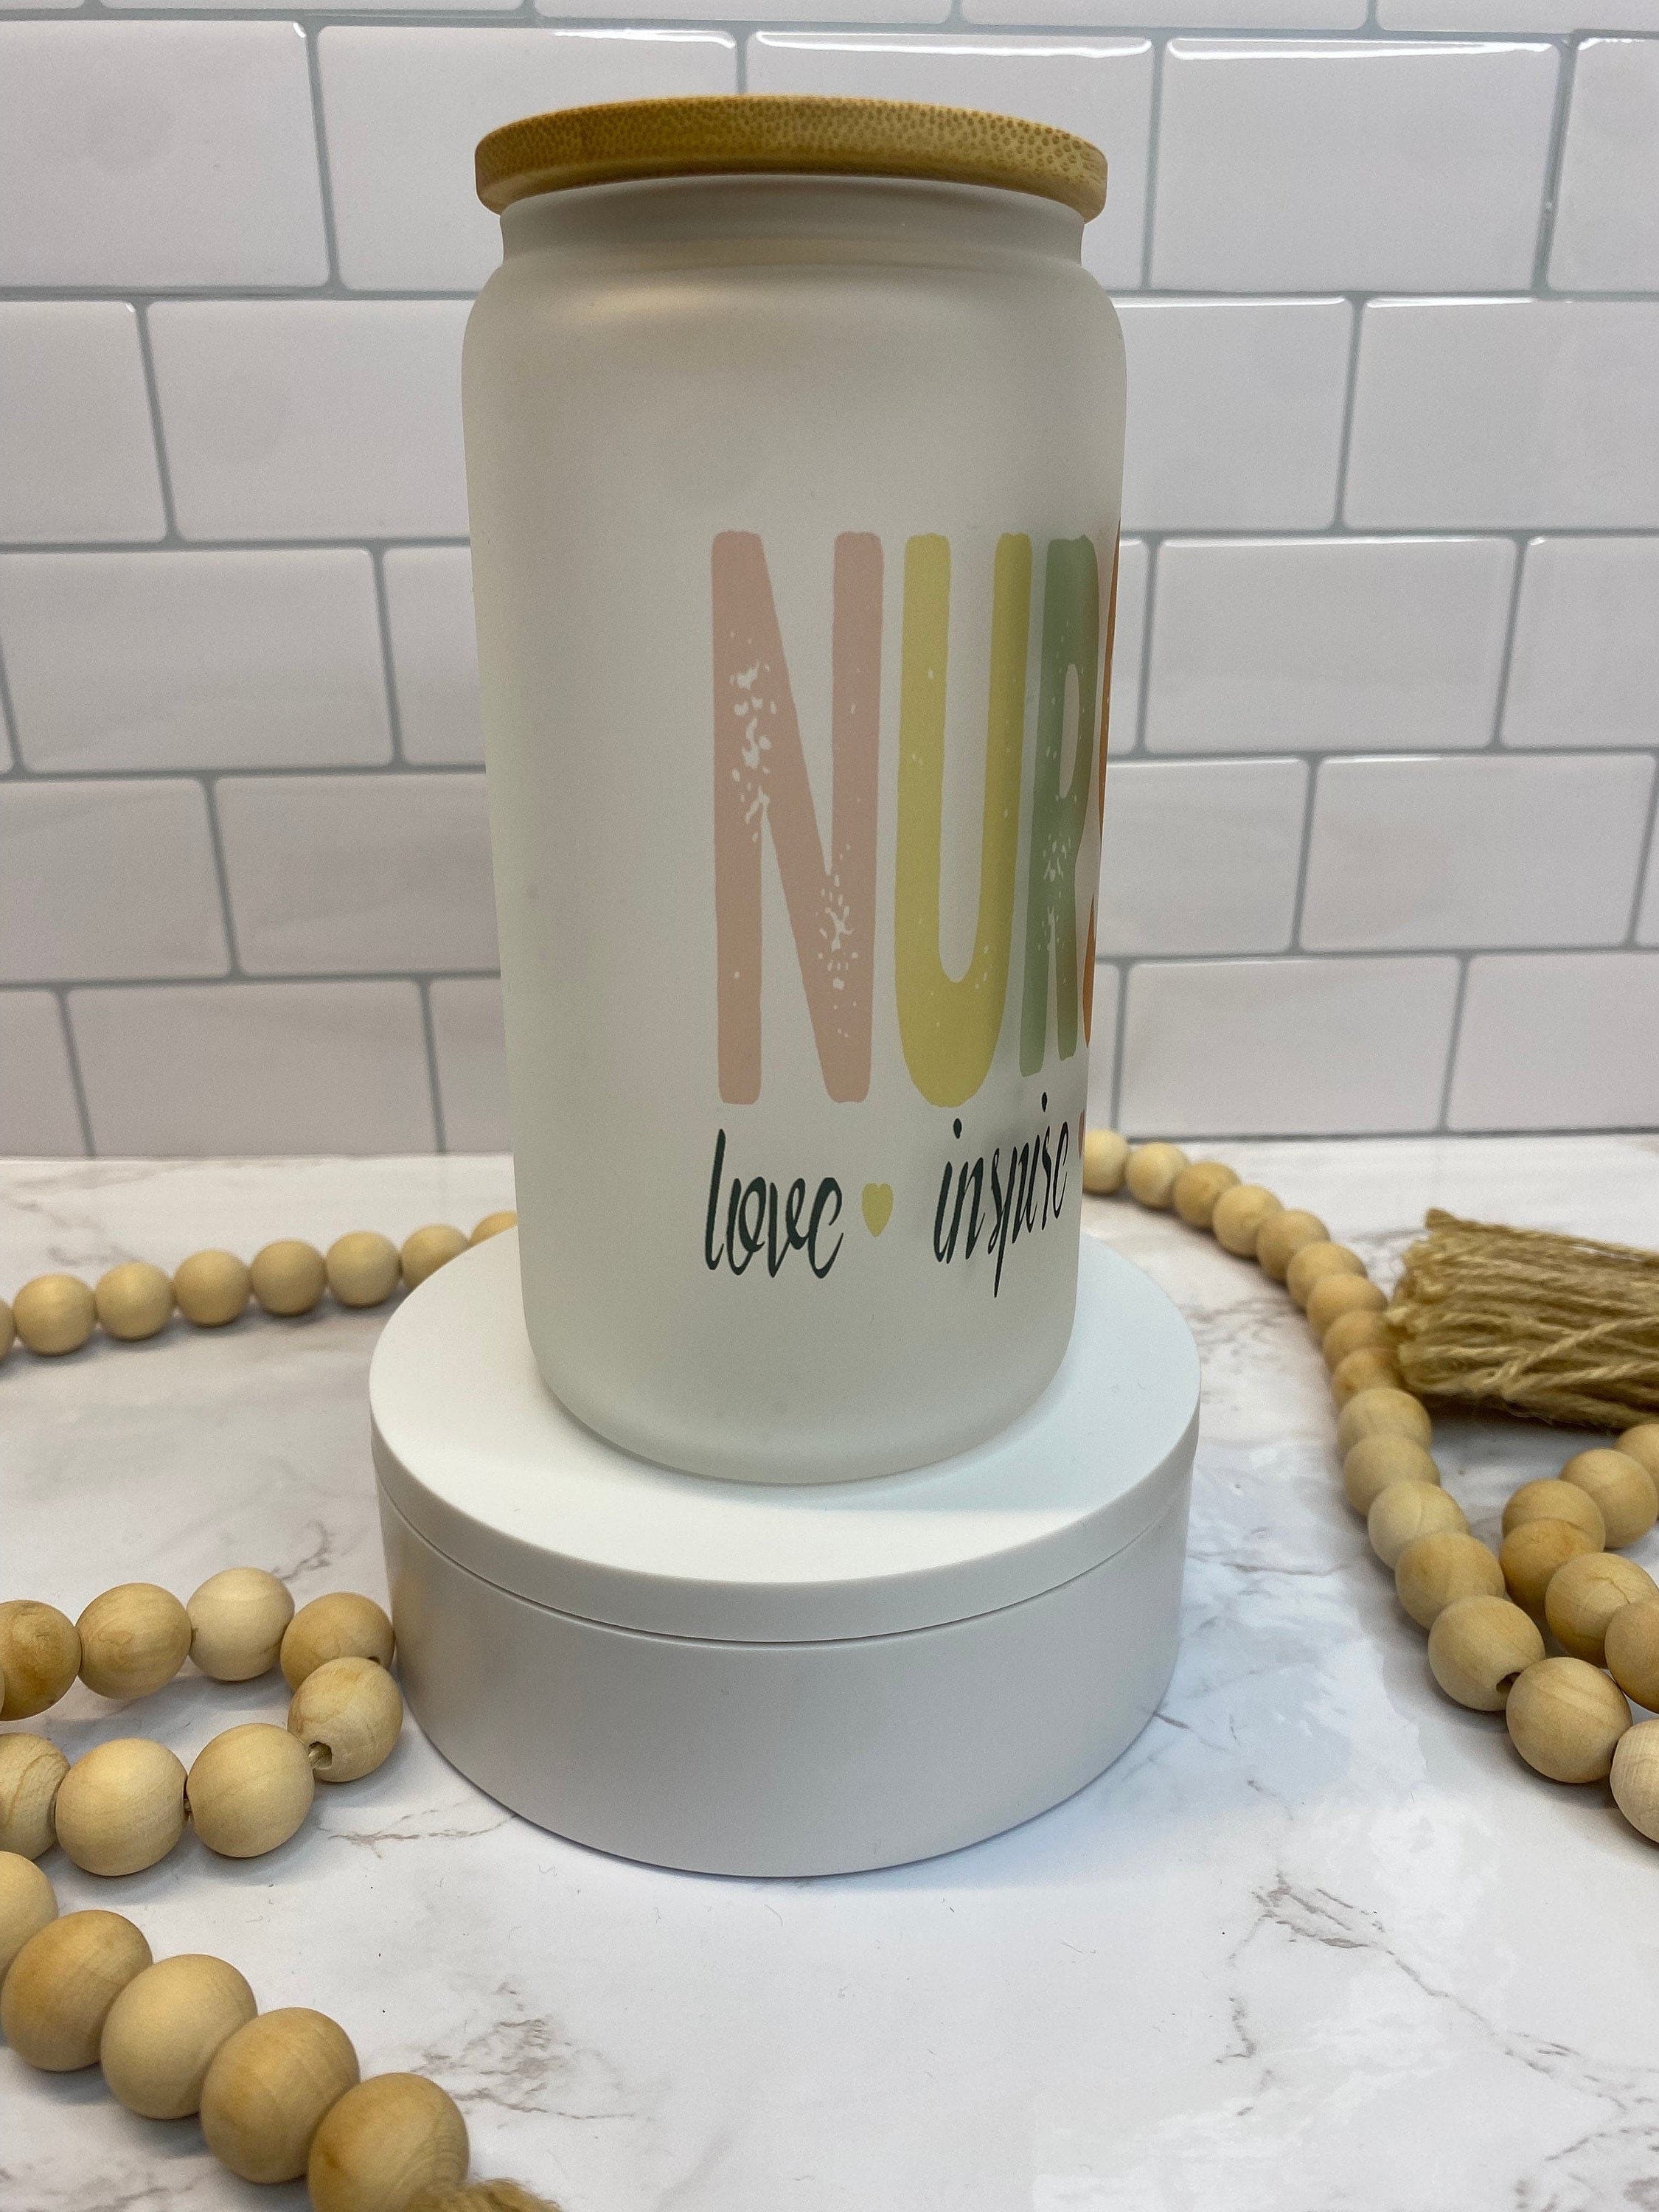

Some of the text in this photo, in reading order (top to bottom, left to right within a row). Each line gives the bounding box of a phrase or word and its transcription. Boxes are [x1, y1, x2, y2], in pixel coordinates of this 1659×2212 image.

[712, 529, 1119, 1107] NUR
[705, 1091, 1069, 1298] love inspire
